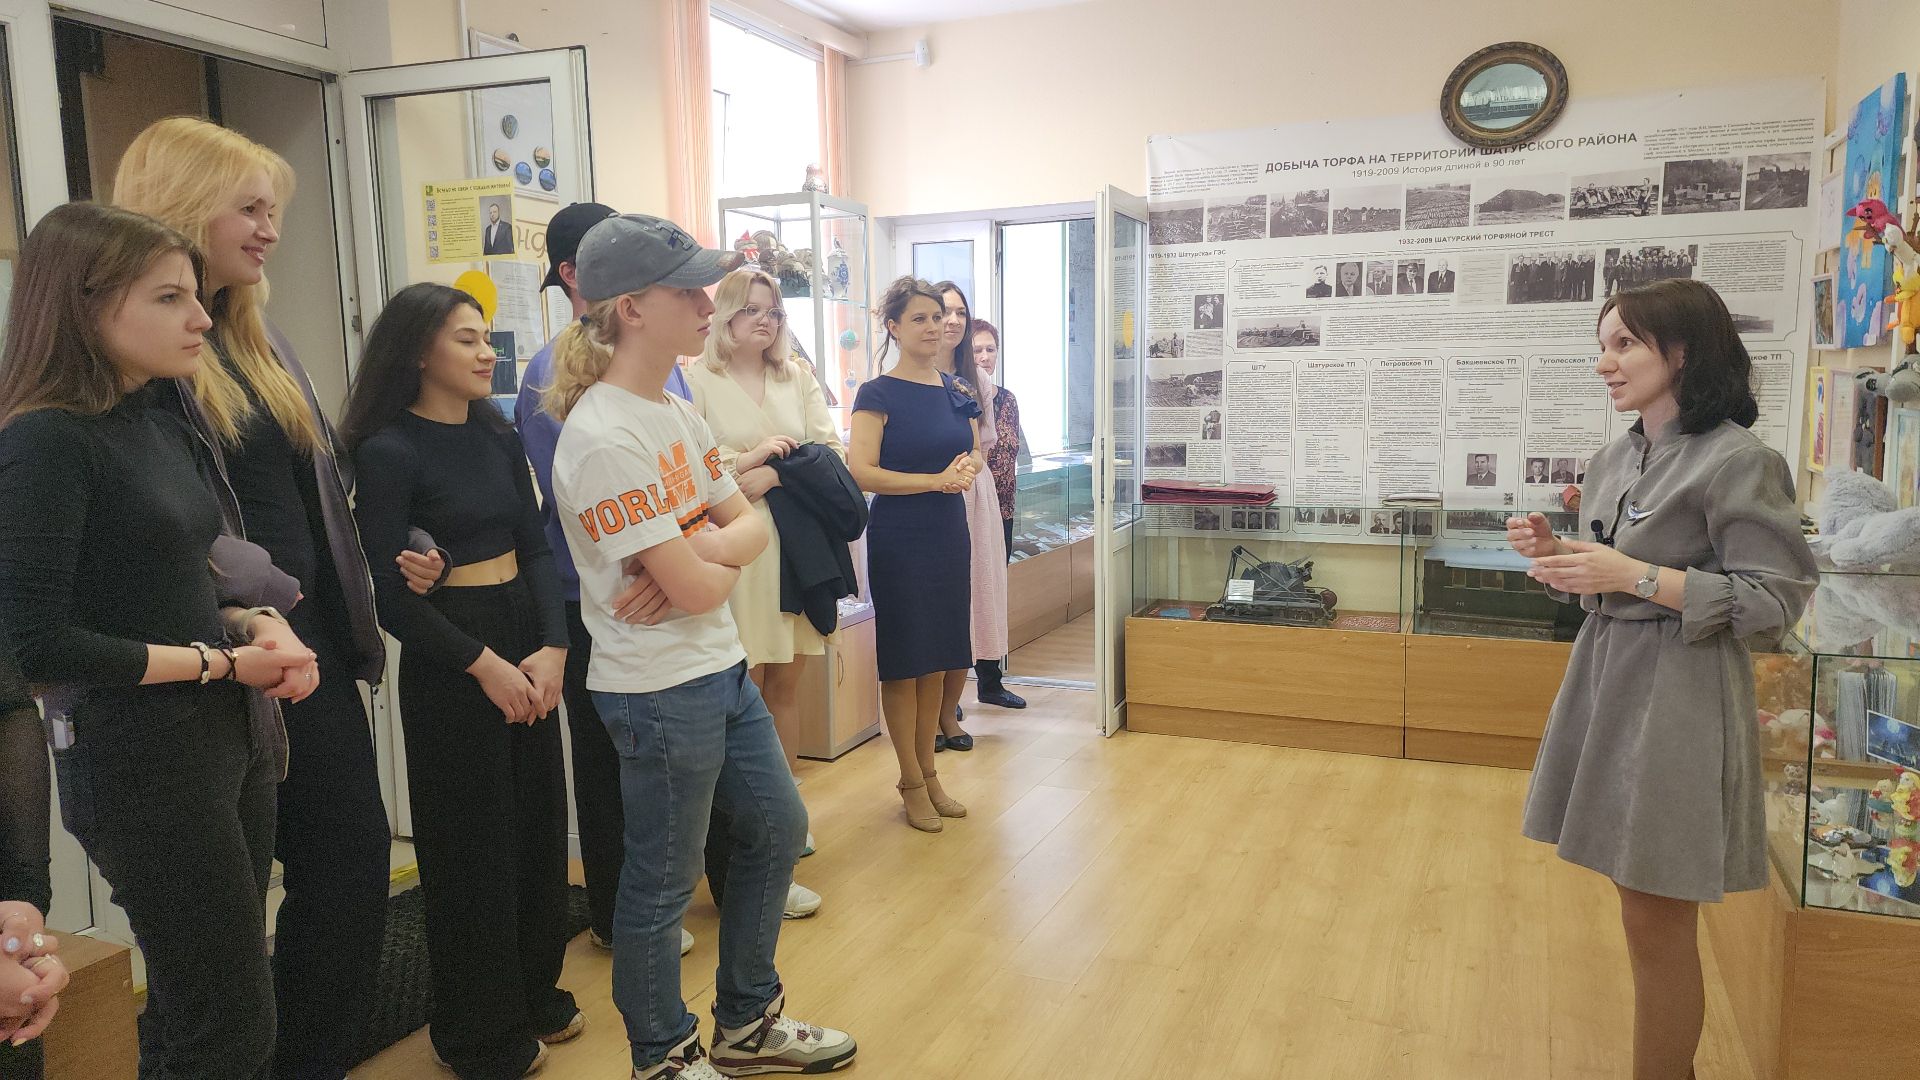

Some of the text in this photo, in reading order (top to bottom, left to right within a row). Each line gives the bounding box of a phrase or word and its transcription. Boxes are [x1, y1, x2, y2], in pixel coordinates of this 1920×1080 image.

[1265, 132, 1638, 174] ДОБЫЧА ТОРФА НА ТЕРРИТОРИИ ШАТУРСКОГО РАЙОНА
[1351, 166, 1400, 178] 1919-2009
[1402, 164, 1442, 175] История
[1445, 160, 1481, 171] длиной
[1493, 159, 1505, 167] 90
[1508, 157, 1526, 166] лет
[1398, 230, 1556, 246] 1932-2009 ШАТУРСКИЙ ТОРФЯНОЙ ТРЕСТ
